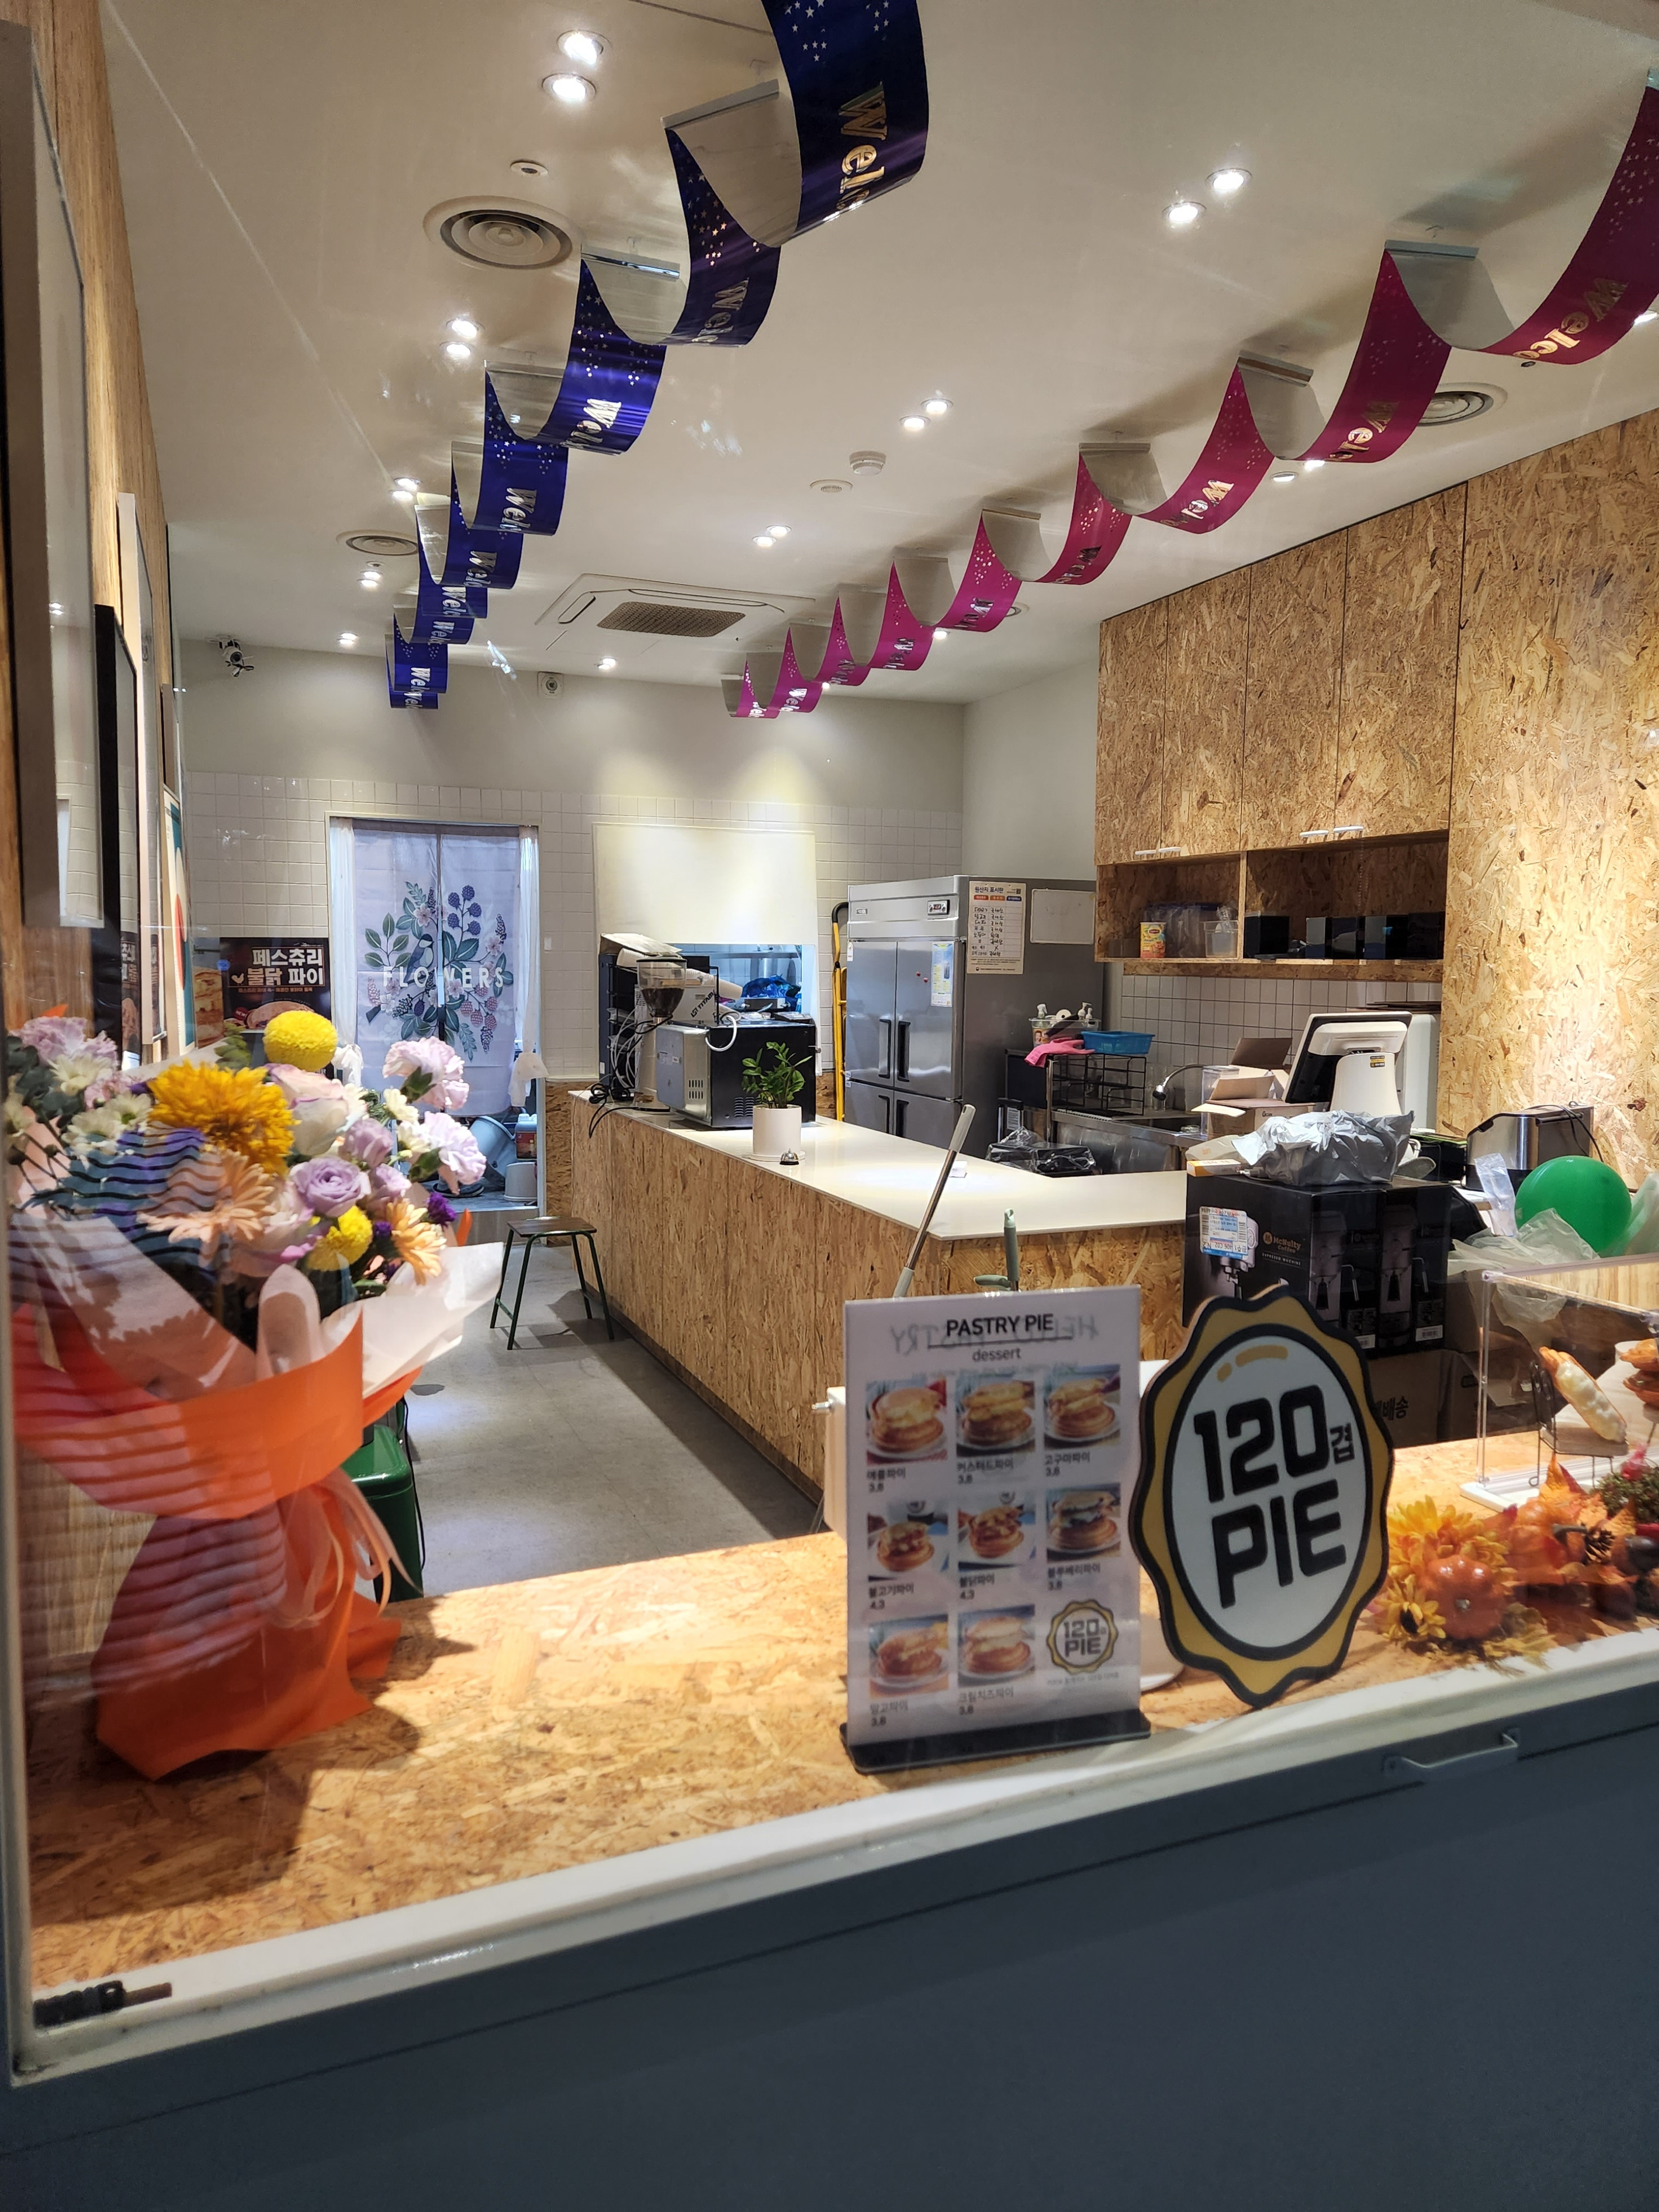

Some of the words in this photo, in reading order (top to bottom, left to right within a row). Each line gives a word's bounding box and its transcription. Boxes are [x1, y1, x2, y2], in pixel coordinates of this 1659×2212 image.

[252, 948, 323, 966] 페스츄리
[247, 968, 282, 985] 불닭
[288, 968, 323, 985] 파이
[1274, 1237, 1301, 1251] McNulty
[1277, 1245, 1296, 1254] Coffee
[946, 1316, 1020, 1337] PASTRY
[1025, 1313, 1054, 1332] PIE
[972, 1347, 1021, 1362] dessert
[1194, 1384, 1330, 1503] 120
[1329, 1423, 1355, 1464] 겹
[1045, 1451, 1090, 1465] 고구마파이
[958, 1474, 973, 1484] 3.8
[1046, 1467, 1060, 1477] 3.8
[1212, 1479, 1347, 1609] PIE
[869, 1583, 914, 1599] 불고기파이
[960, 1589, 974, 1600] 4.3
[1064, 1619, 1099, 1639] 120
[1065, 1637, 1101, 1657] PIE
[959, 1687, 1014, 1703] 크림치즈파이
[959, 1705, 974, 1715] 3.8
